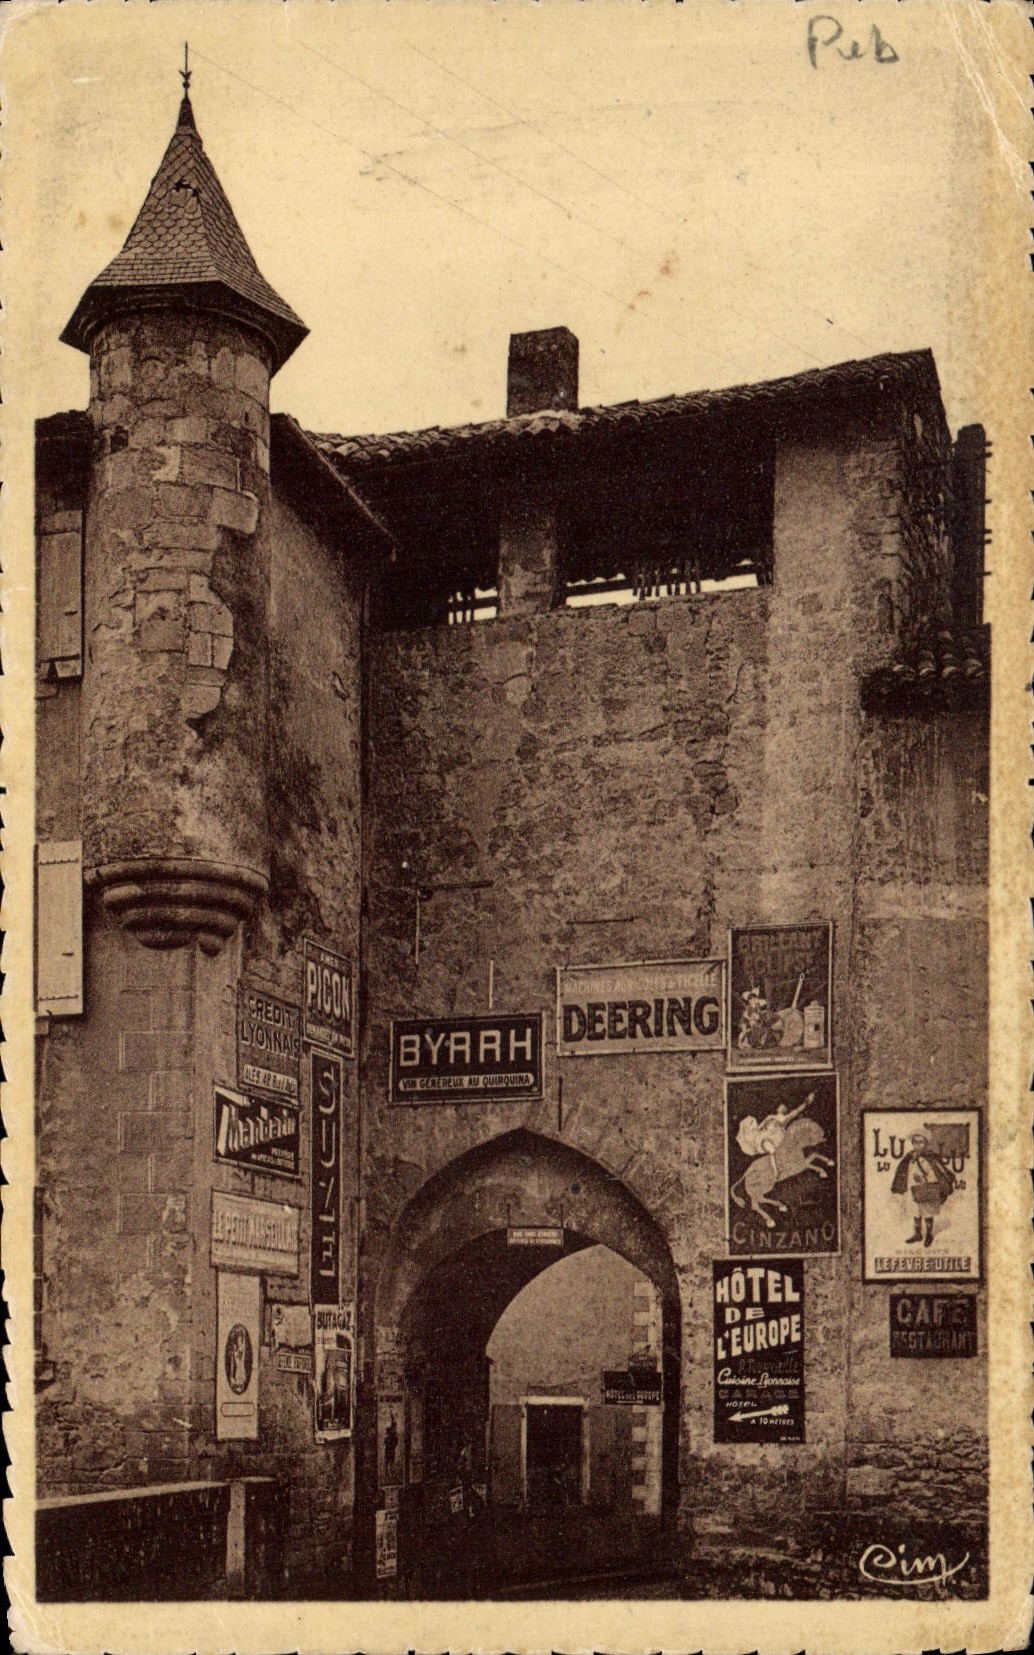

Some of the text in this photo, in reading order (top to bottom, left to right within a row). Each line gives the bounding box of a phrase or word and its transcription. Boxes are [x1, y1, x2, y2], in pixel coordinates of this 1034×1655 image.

[306, 960, 350, 1022] PICON
[562, 996, 720, 1042] DEERING
[240, 1021, 299, 1060] LYONNAIS
[400, 1028, 532, 1067] BYRRH
[402, 1078, 417, 1089] VIN
[468, 1077, 480, 1088] AU
[483, 1074, 531, 1088] QUINQUINA
[319, 1063, 336, 1277] SUZE
[733, 1221, 835, 1249] CINZANO
[716, 1267, 800, 1303] HÔTEL
[317, 1310, 352, 1331] BUTAGAZ
[725, 1307, 766, 1325] DE
[717, 1314, 801, 1360] L'EUROPE
[718, 1367, 800, 1389] Cuisine Lyonnaise
[719, 1389, 800, 1399] GARAGE
[759, 1417, 768, 1425] 10
